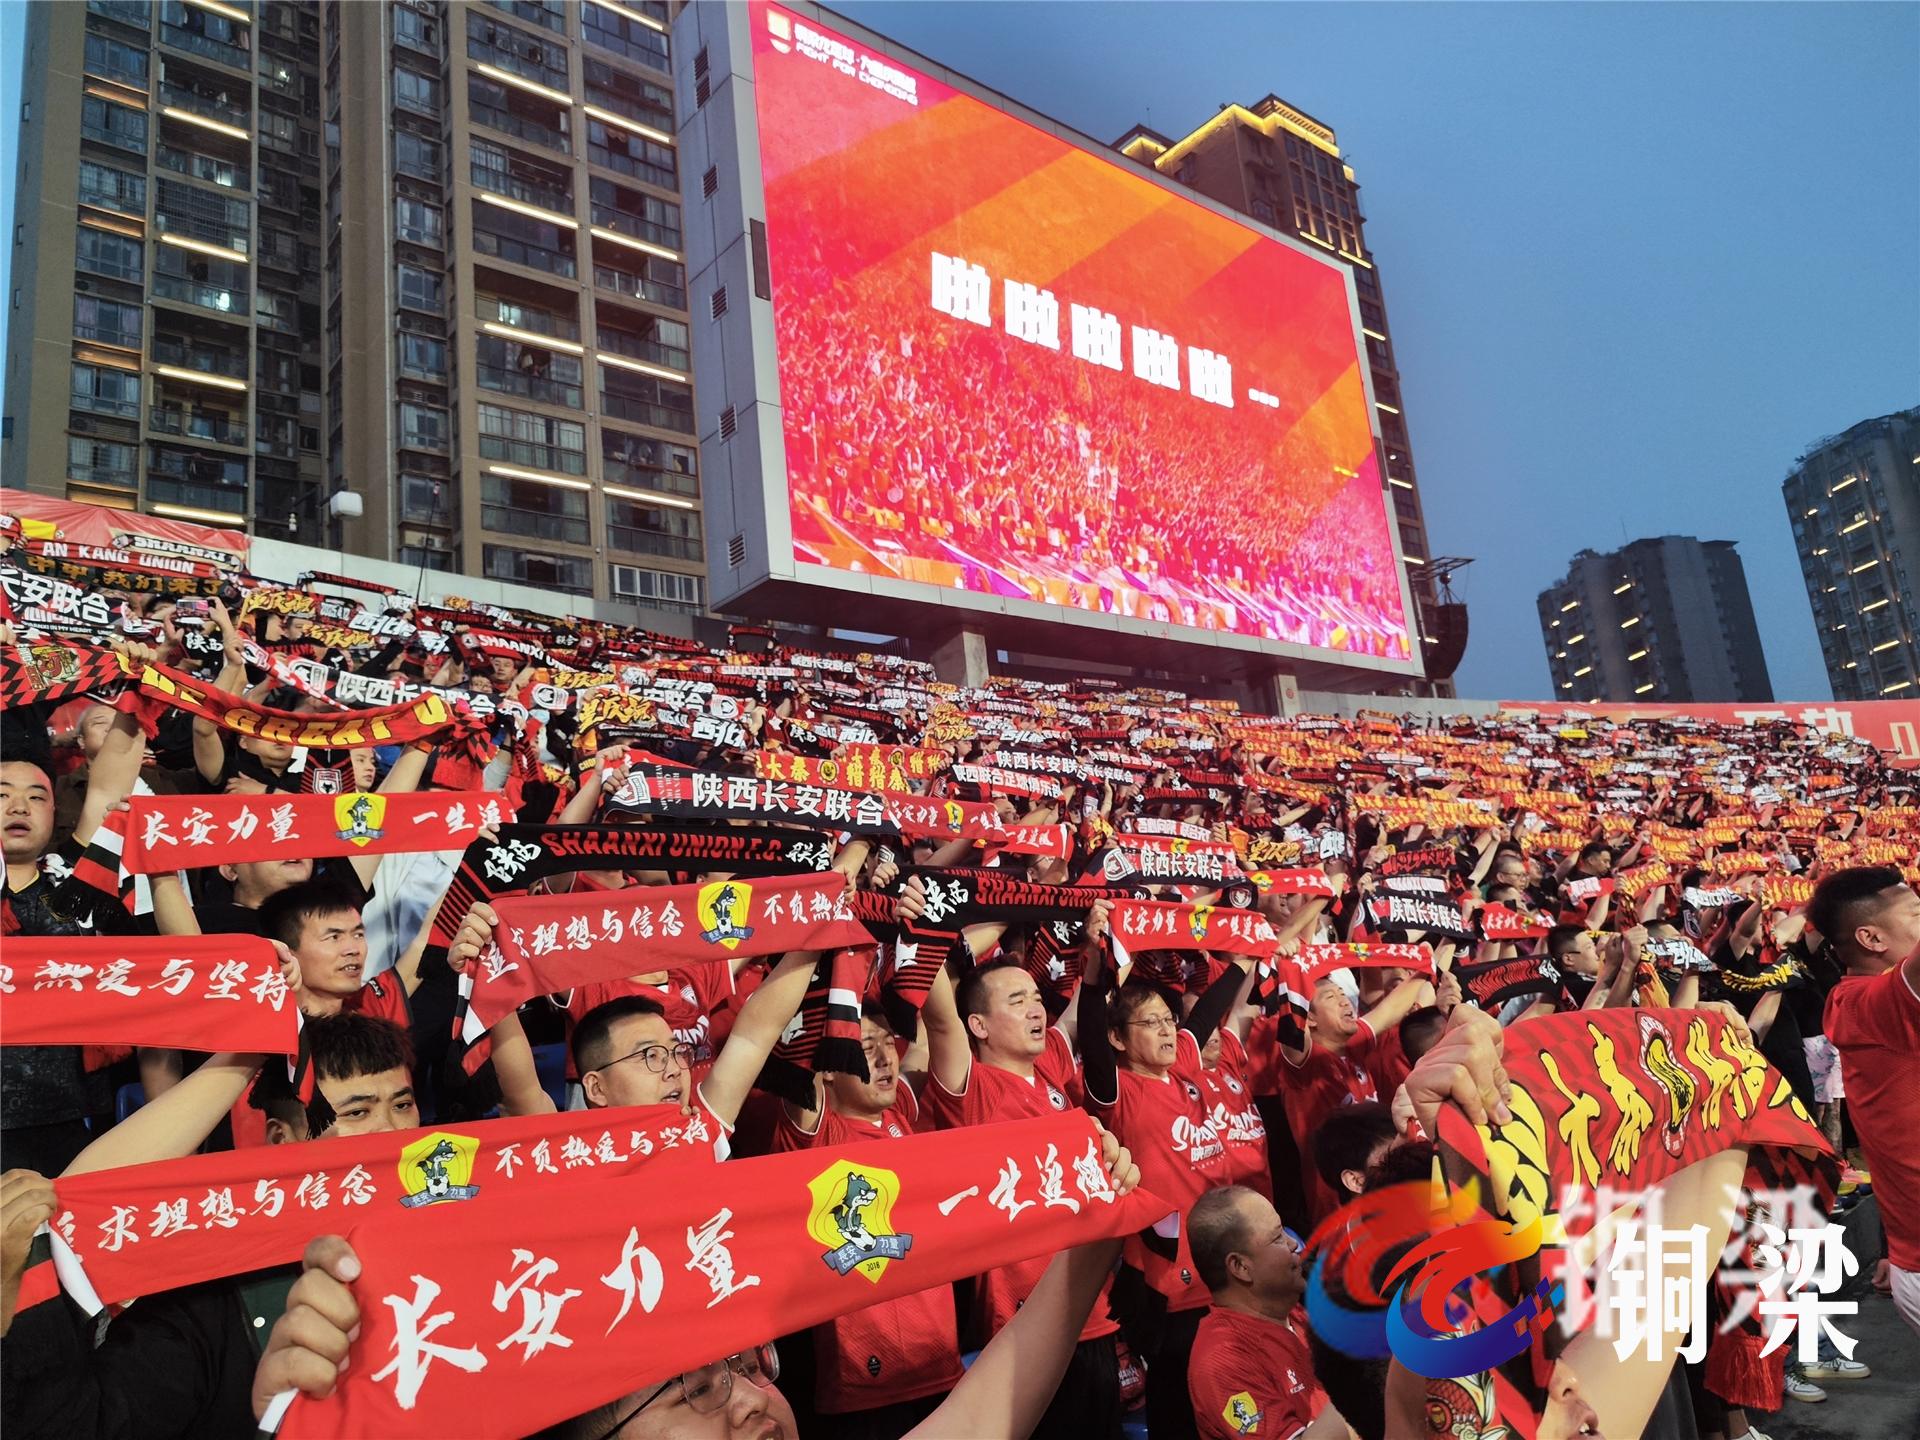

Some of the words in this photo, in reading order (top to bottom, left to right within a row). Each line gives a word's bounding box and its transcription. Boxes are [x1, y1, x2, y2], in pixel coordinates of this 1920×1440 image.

[79, 545, 130, 564] KANG
[139, 553, 195, 574] UNION
[692, 773, 886, 826] 陕西长安联合
[141, 801, 300, 851] 长安力量
[412, 798, 516, 834] 一生追
[484, 838, 541, 883] 陕西
[541, 831, 667, 857] SHAANXI
[669, 833, 741, 860] UNION
[785, 842, 832, 872] 联合
[1141, 848, 1222, 881] 陕西长安联合
[1123, 906, 1178, 935] 长安力量
[1389, 896, 1464, 933] 陕西长安联合
[938, 1136, 1116, 1223] 一生追随
[370, 1207, 761, 1411] 长安力量
